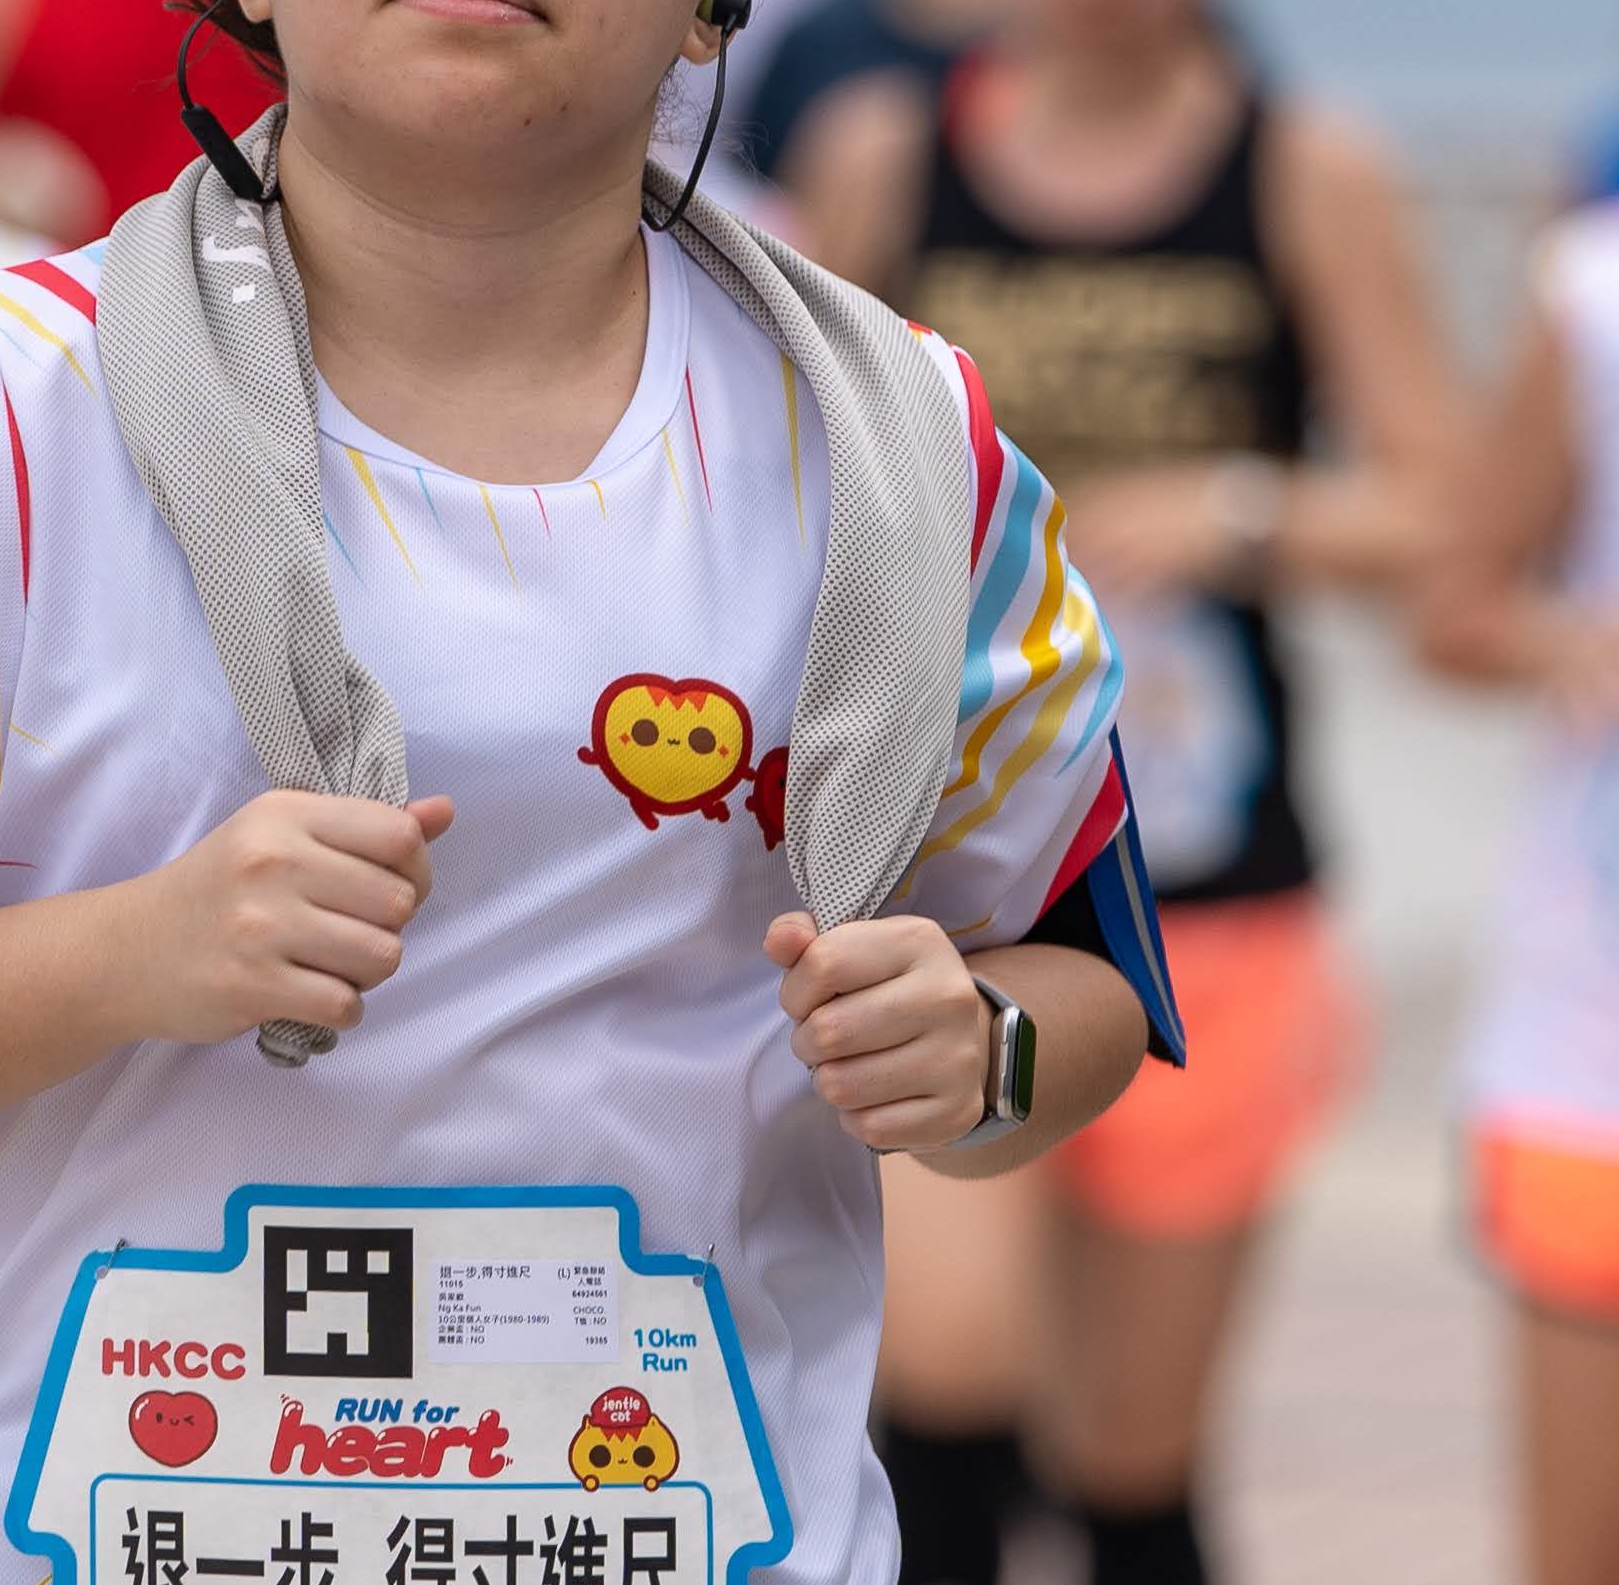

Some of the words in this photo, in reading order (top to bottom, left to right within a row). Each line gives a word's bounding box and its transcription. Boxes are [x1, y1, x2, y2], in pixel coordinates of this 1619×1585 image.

[633, 1328, 698, 1349] 10km
[101, 1337, 247, 1382] HKCC
[642, 1352, 688, 1372] Run
[334, 1397, 404, 1423] RUN
[412, 1399, 460, 1424] for
[602, 1396, 641, 1412] jentle
[269, 1399, 510, 1479] heart
